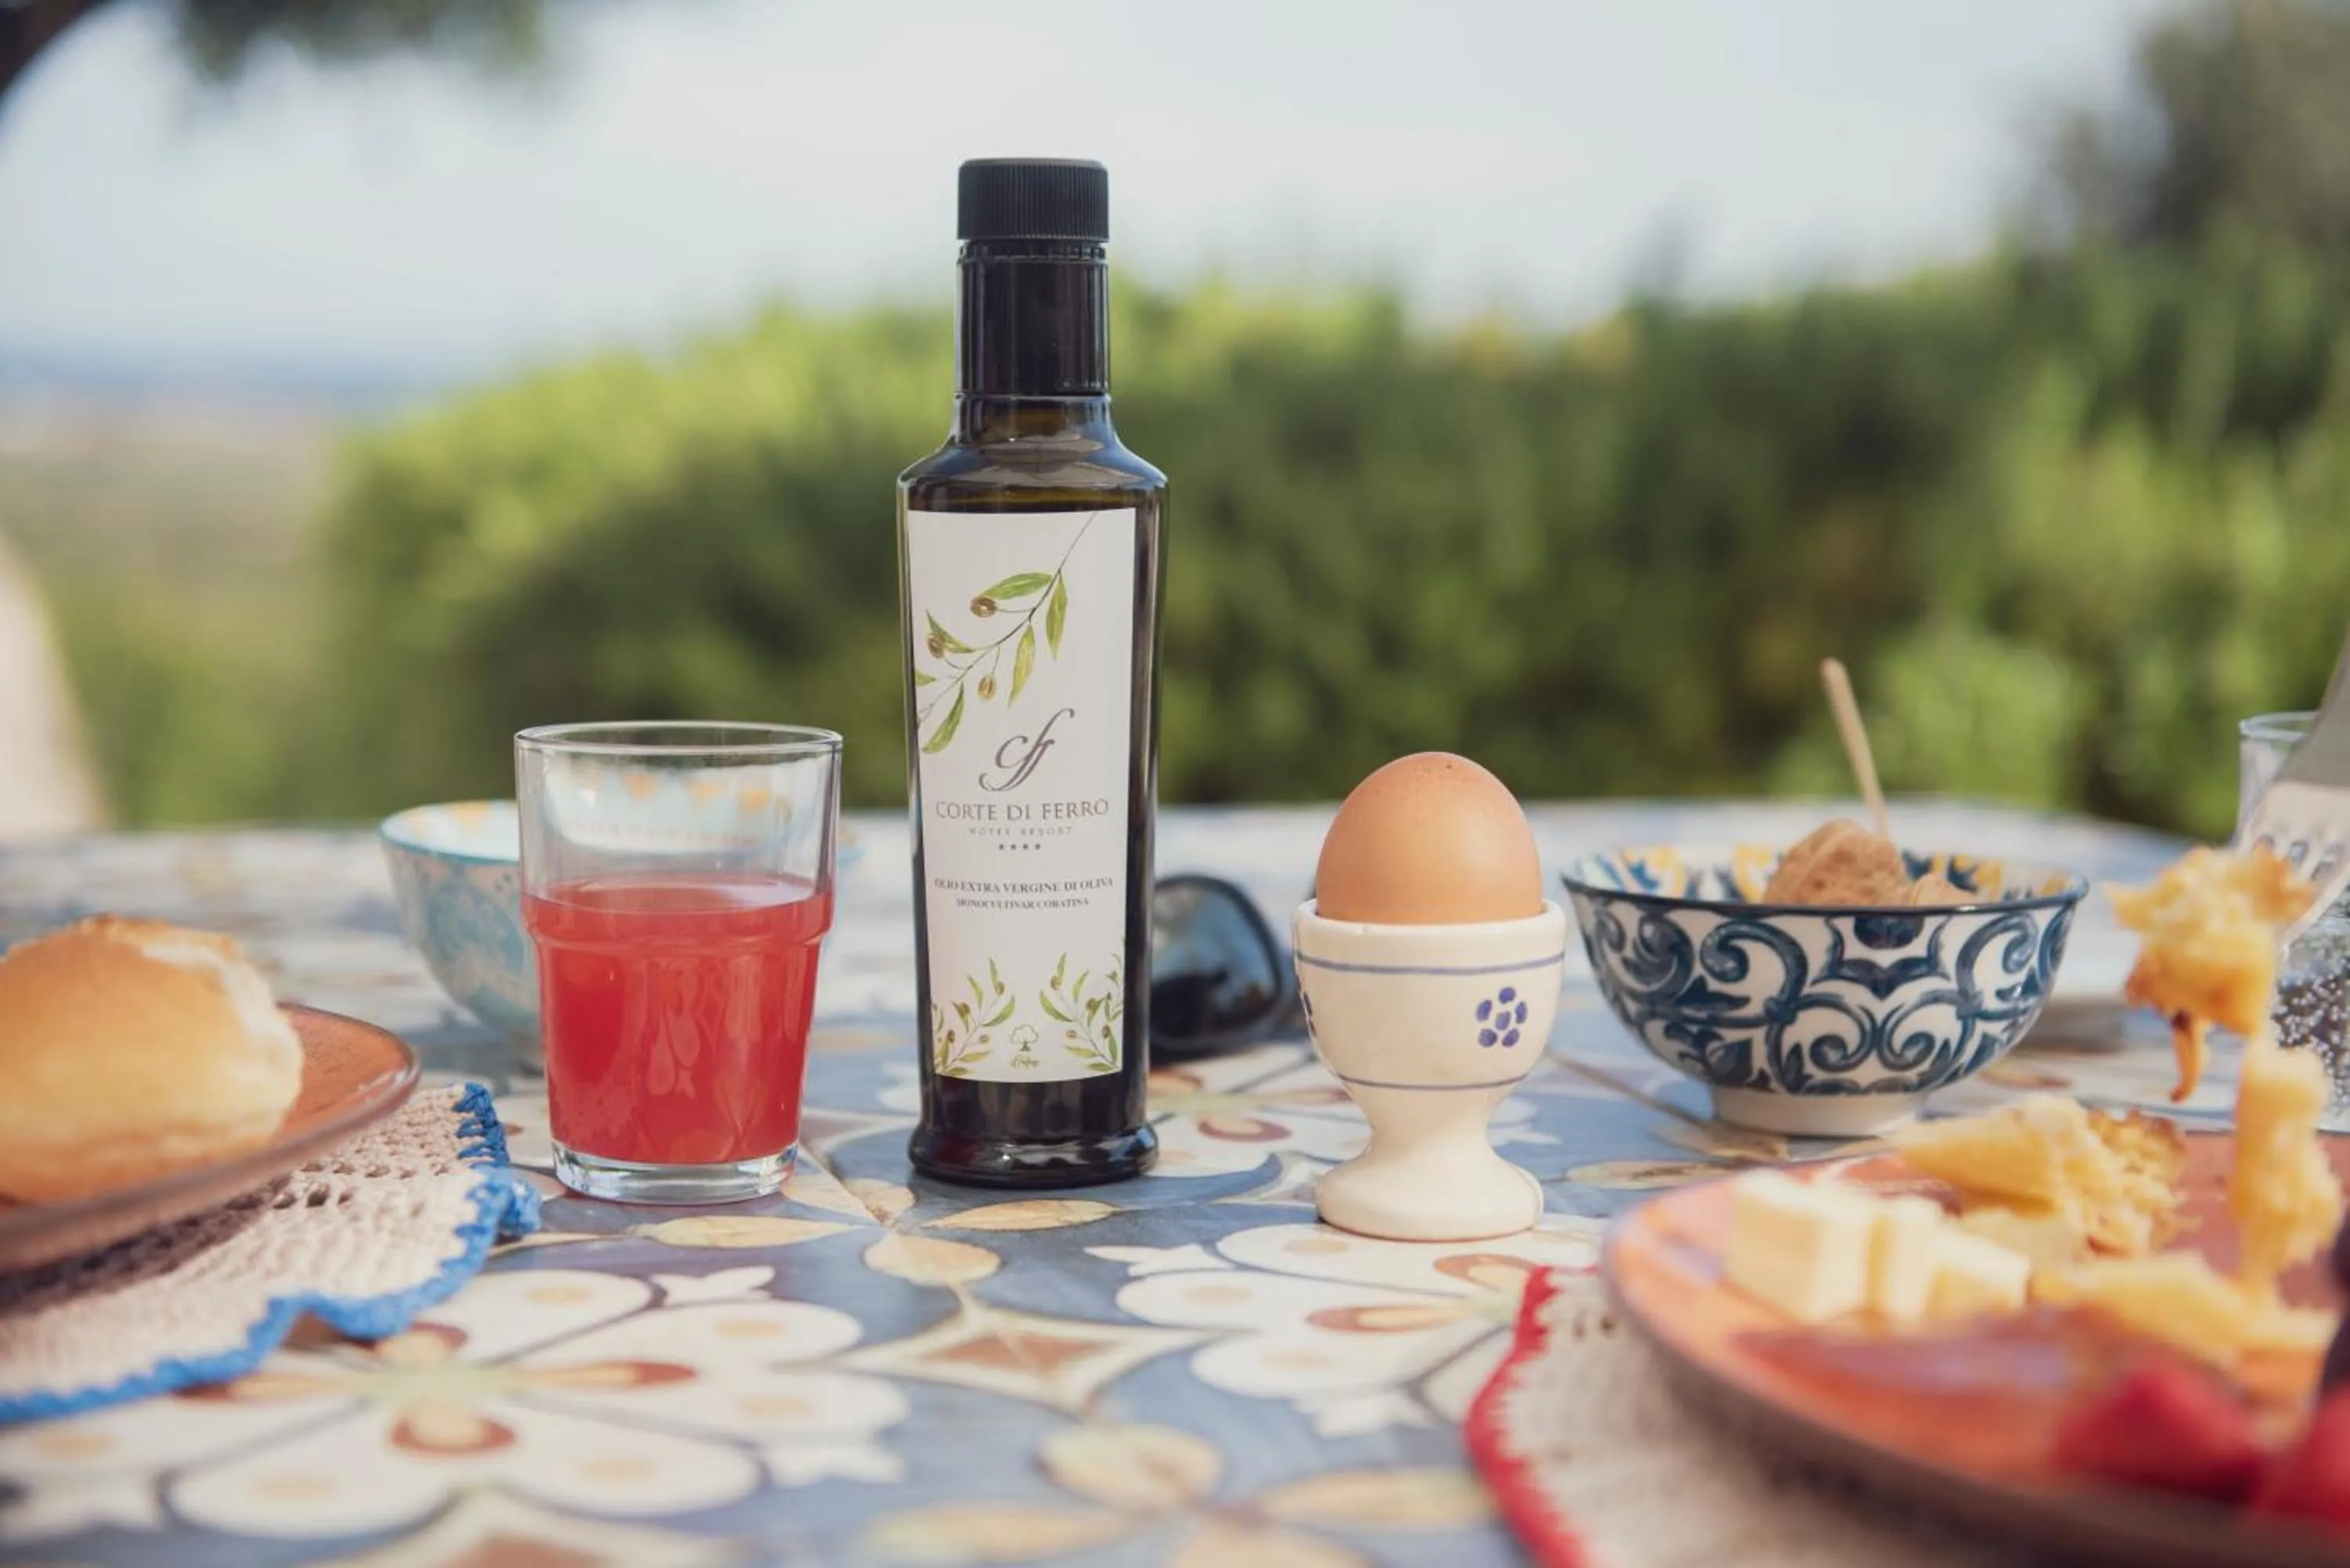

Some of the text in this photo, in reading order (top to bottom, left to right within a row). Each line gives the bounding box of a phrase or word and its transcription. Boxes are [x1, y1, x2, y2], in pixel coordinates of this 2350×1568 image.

[935, 798, 1109, 822] CORTE DI FERRO
[960, 880, 1000, 893] EXTRA
[1003, 882, 1058, 894] VERGINE
[1064, 880, 1078, 891] DI
[1079, 877, 1113, 890] OLIVA
